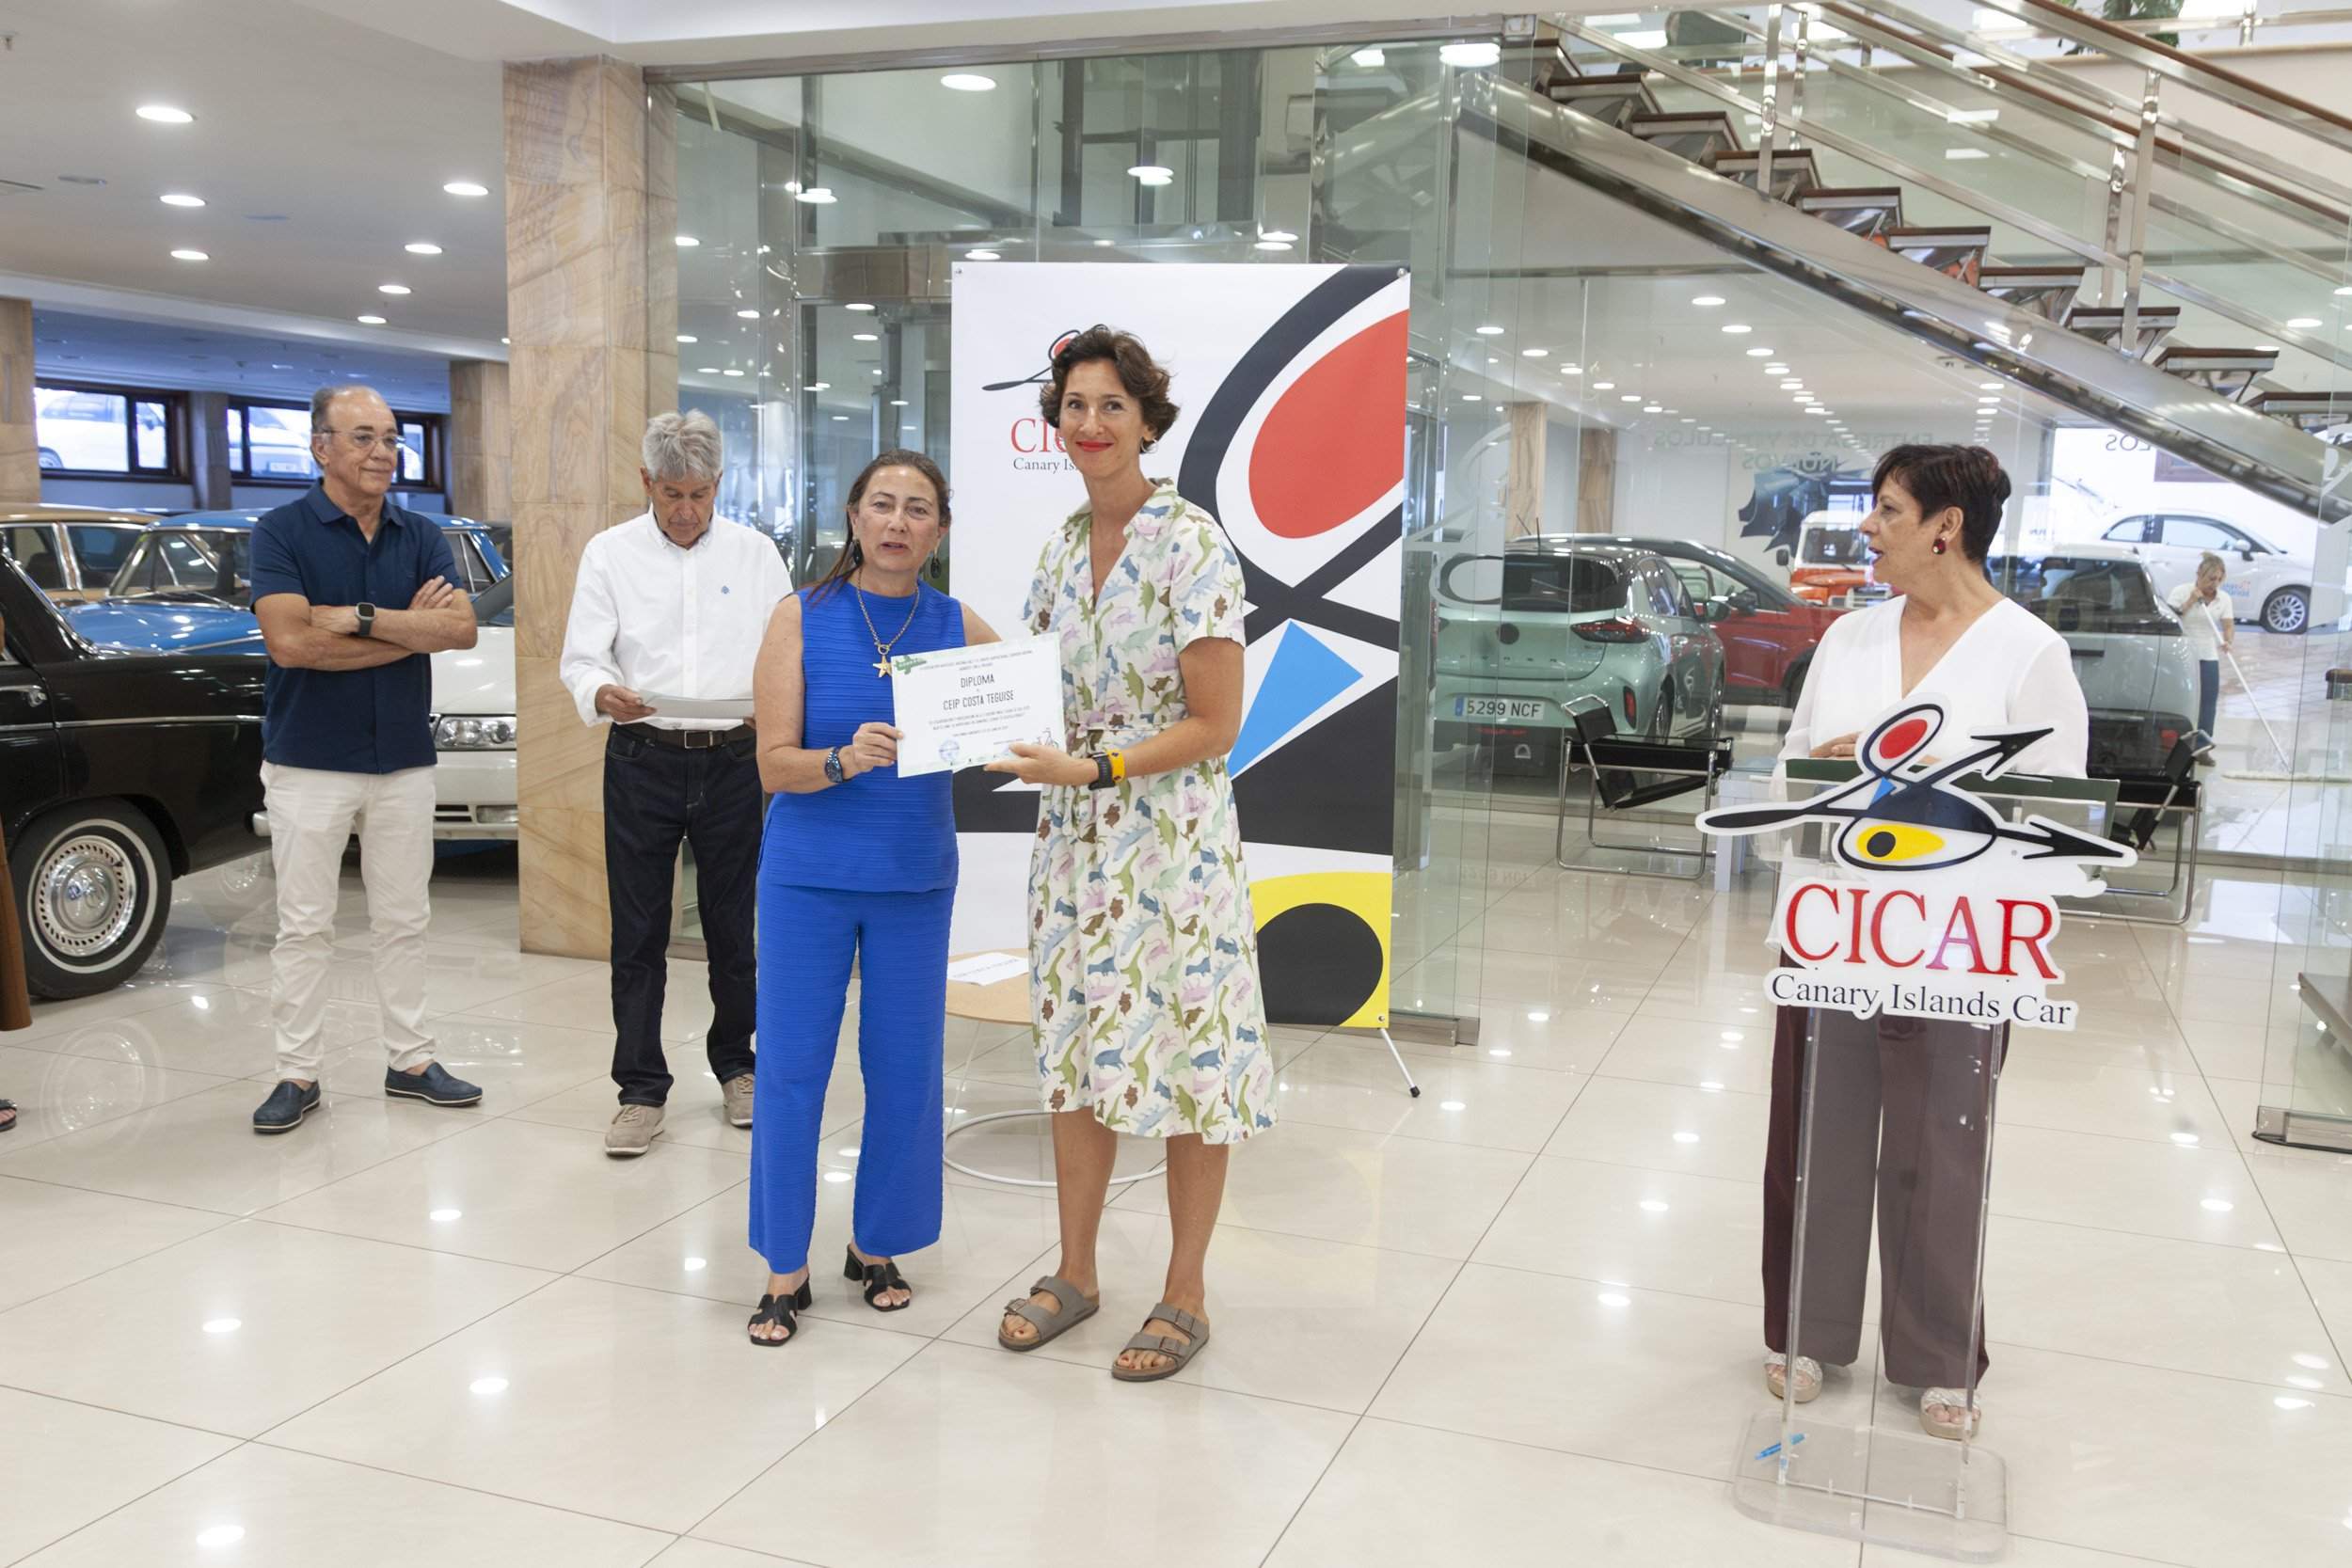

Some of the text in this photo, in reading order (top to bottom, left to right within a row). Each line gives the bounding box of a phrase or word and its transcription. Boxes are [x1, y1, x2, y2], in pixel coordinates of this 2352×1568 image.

[1013, 457, 1078, 474] Canary Is
[961, 673, 994, 688] DIPLOMA
[943, 689, 1014, 710] CEIP COSTA TEGUISE
[1467, 700, 1542, 718] 5299 NCF
[1786, 883, 2058, 979] CICAR
[1772, 974, 2073, 1025] Canary Islands Car
